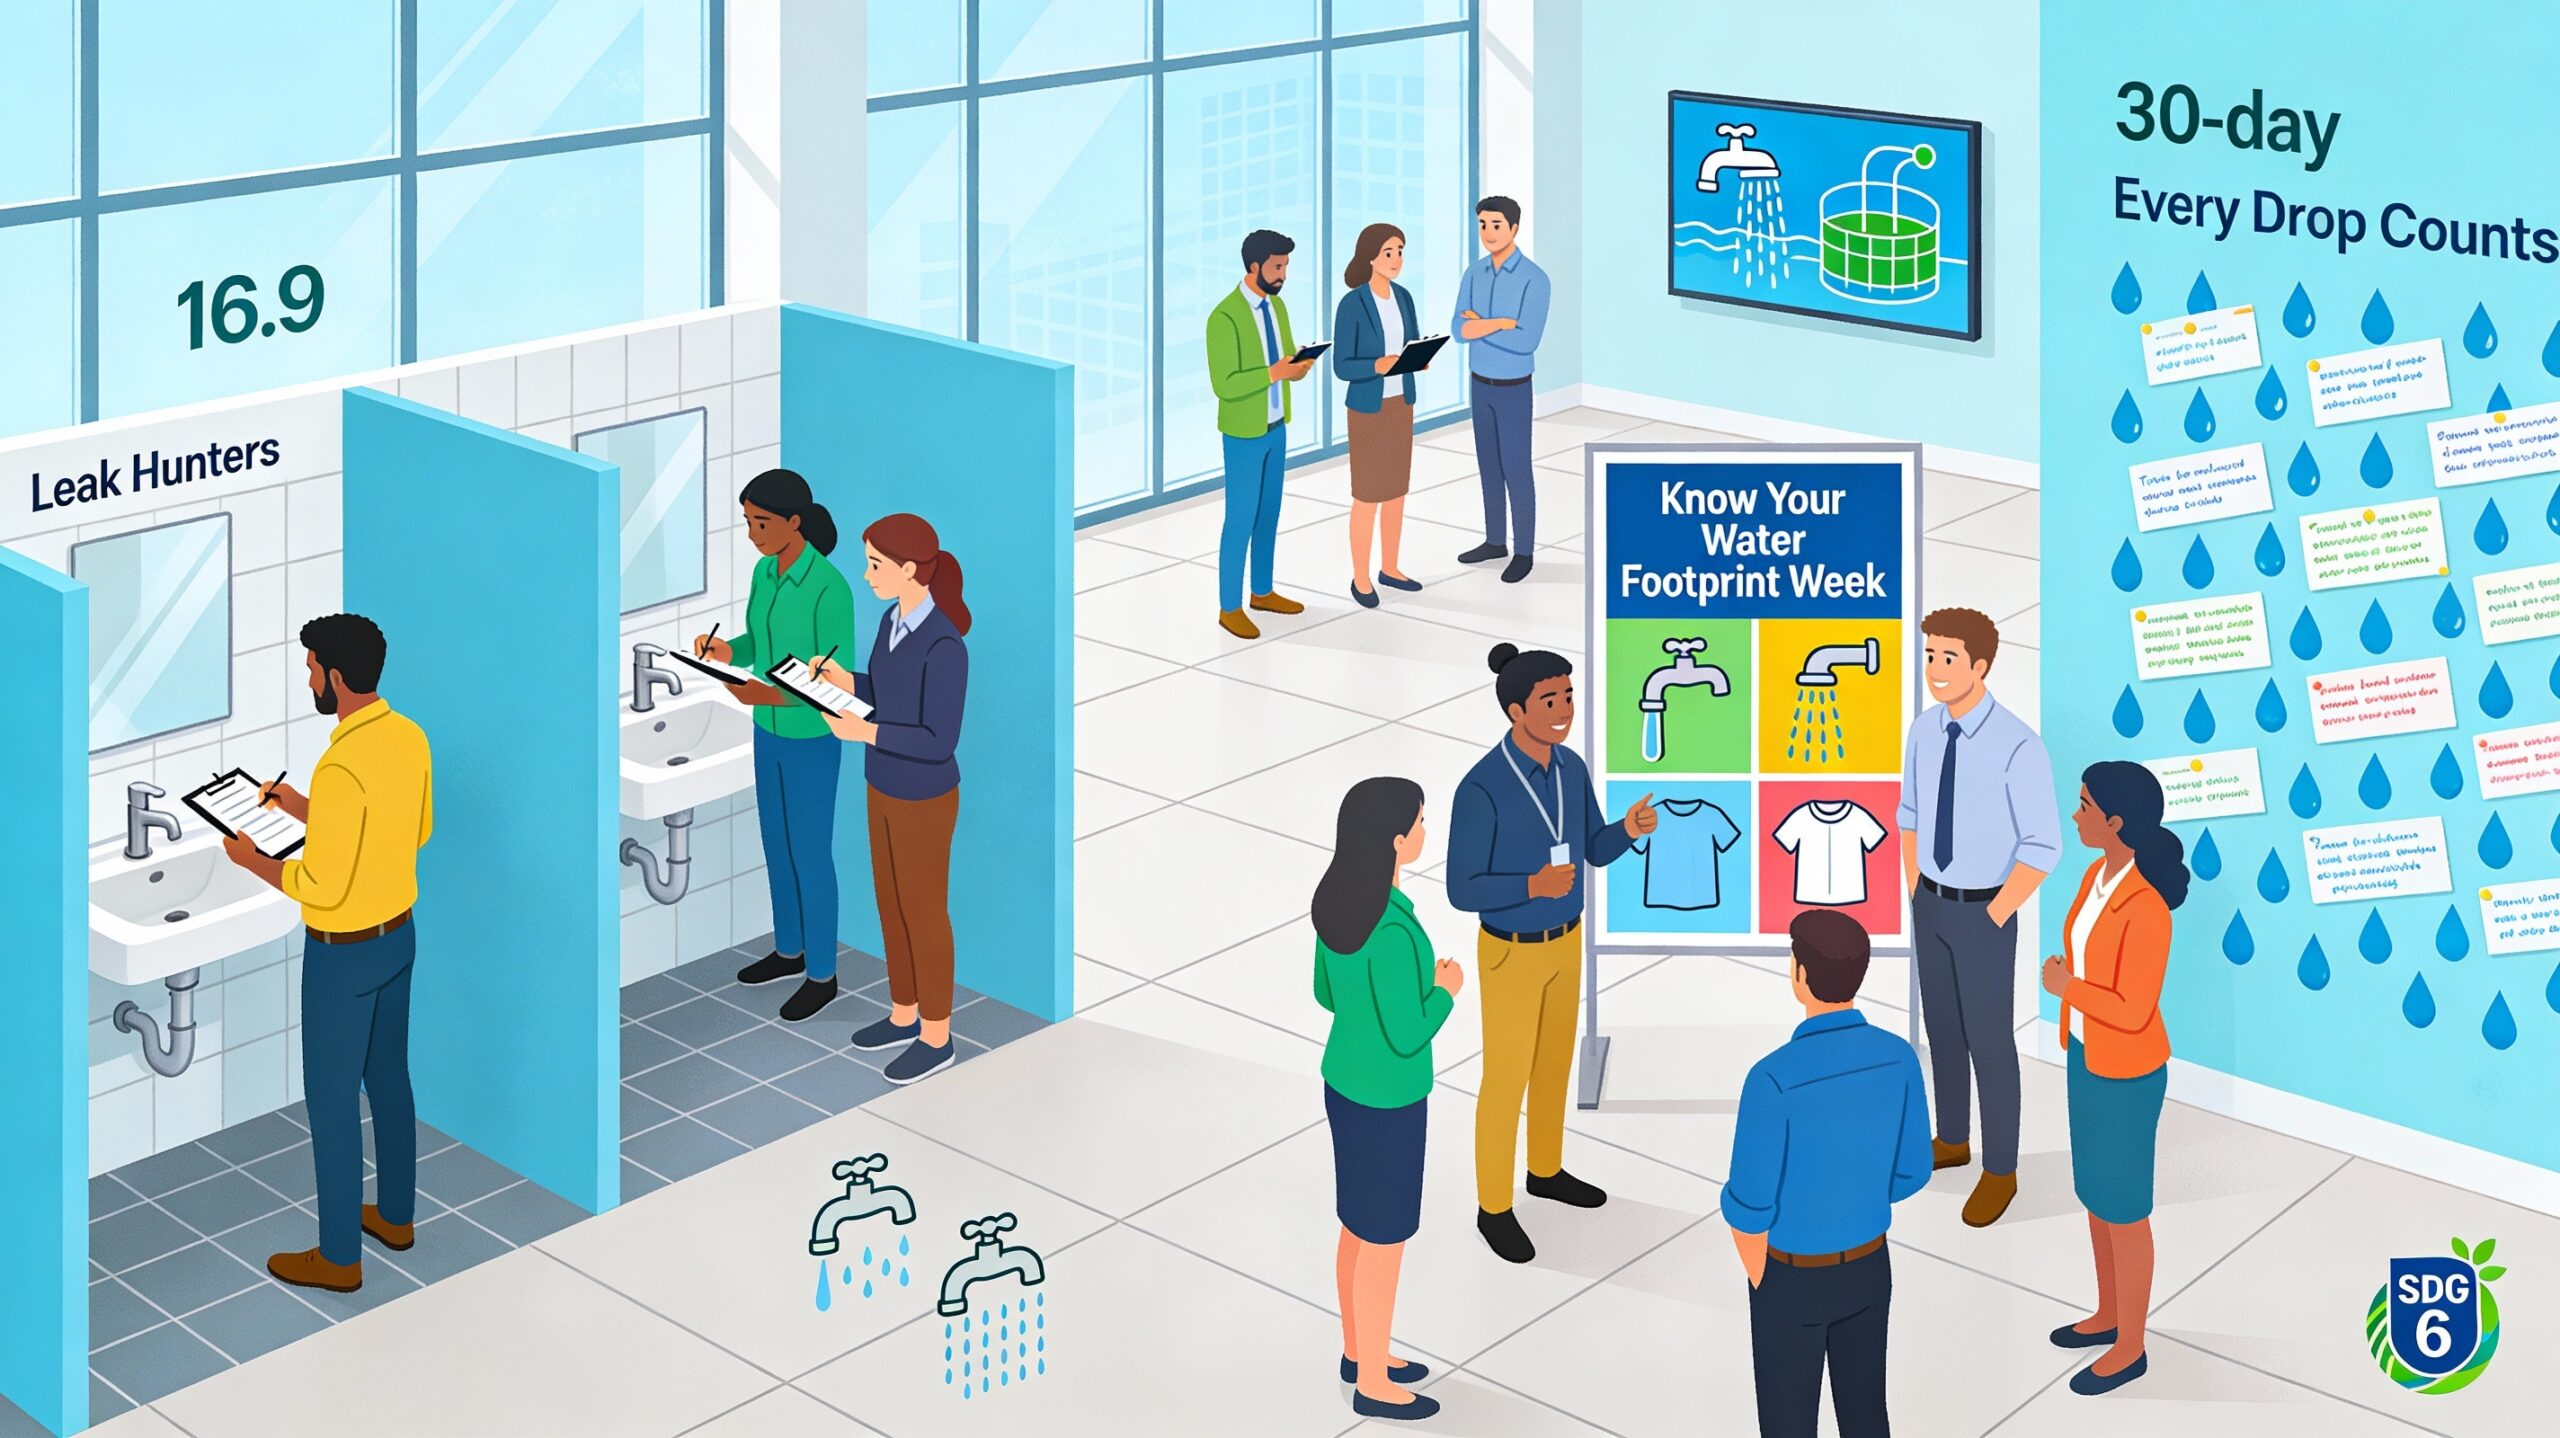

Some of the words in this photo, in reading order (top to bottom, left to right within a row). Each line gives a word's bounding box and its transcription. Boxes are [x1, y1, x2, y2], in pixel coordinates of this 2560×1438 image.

[2115, 80, 2342, 172] 30-day
[2114, 175, 2241, 242] Every
[2253, 189, 2367, 255] Drop
[2380, 202, 2560, 264] Counts
[177, 264, 325, 351] 16.9
[31, 458, 122, 512] Leak
[132, 438, 280, 493] Hunters
[1661, 481, 1758, 515] Know
[1766, 481, 1847, 515] Your
[1701, 523, 1807, 556] Water
[1621, 563, 1781, 607] Footprint
[1789, 562, 1888, 599] Week
